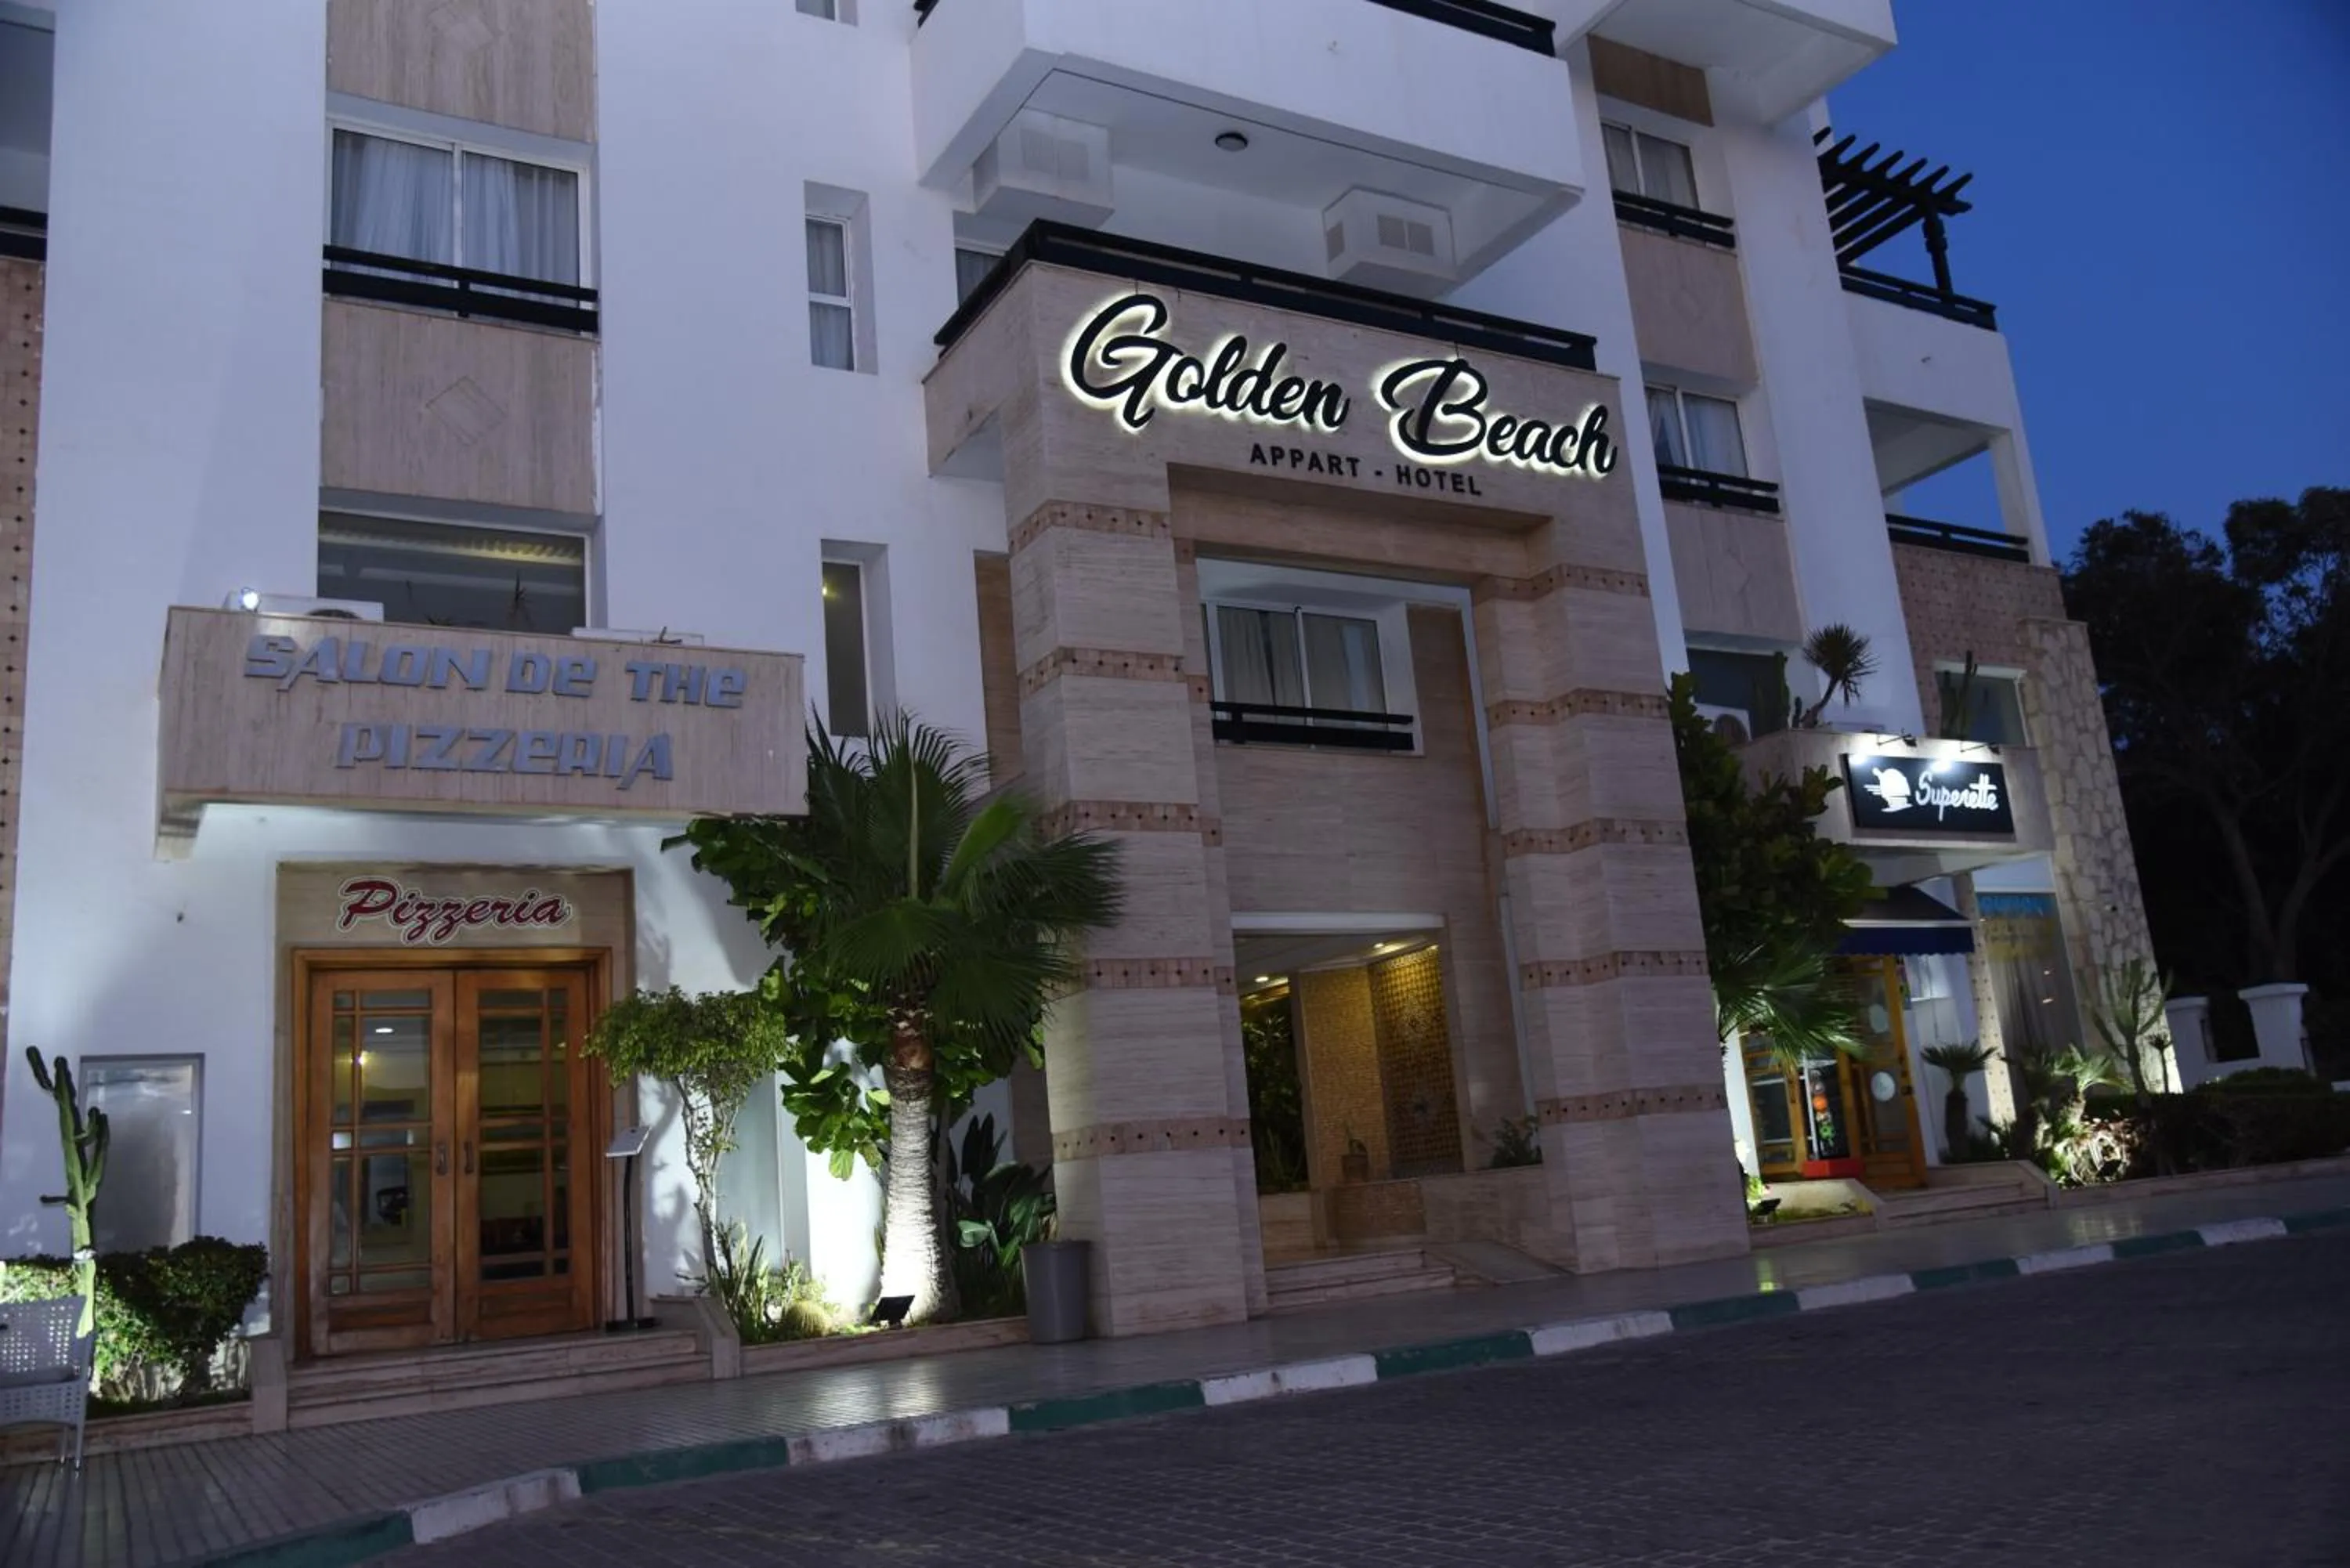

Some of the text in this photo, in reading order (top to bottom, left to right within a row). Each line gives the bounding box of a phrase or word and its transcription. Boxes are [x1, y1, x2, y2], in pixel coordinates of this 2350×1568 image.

[1070, 293, 1618, 474] Golden Beach
[1249, 443, 1361, 477] APPART
[1396, 466, 1482, 497] HOTEL
[244, 634, 492, 691] SALON
[1915, 771, 1998, 822] Superette
[341, 879, 570, 942] Pizzeria
